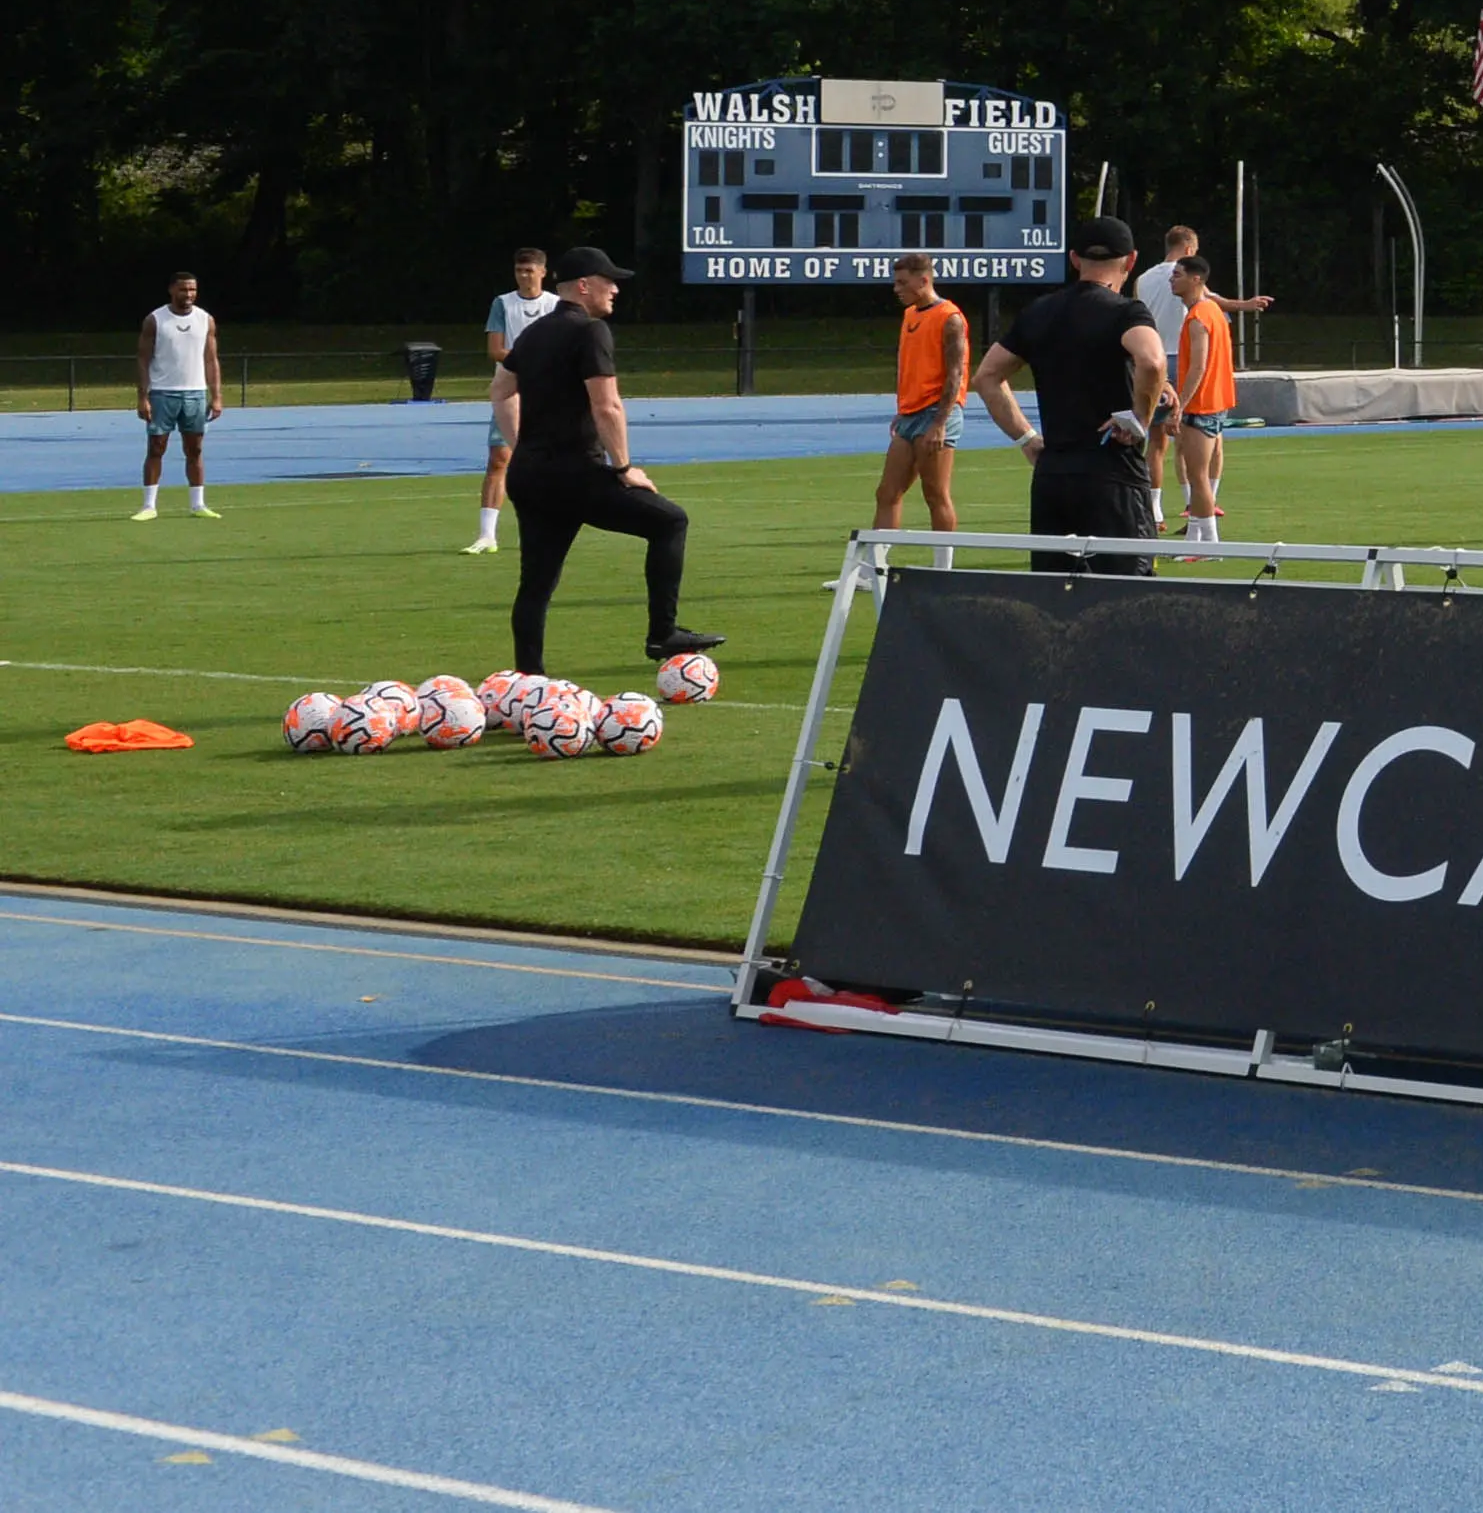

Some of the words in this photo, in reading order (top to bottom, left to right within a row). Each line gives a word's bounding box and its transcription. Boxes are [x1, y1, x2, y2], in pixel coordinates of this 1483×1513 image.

[693, 92, 816, 123] WALSH
[944, 98, 1057, 129] FIELD
[690, 126, 776, 149] KNIGHTS
[988, 132, 1055, 154] GUEST
[693, 226, 733, 246] T.O.L.
[1021, 228, 1058, 247] T.O.L.
[707, 257, 791, 278] HOME
[804, 257, 840, 278] OF
[852, 258, 899, 278] TH
